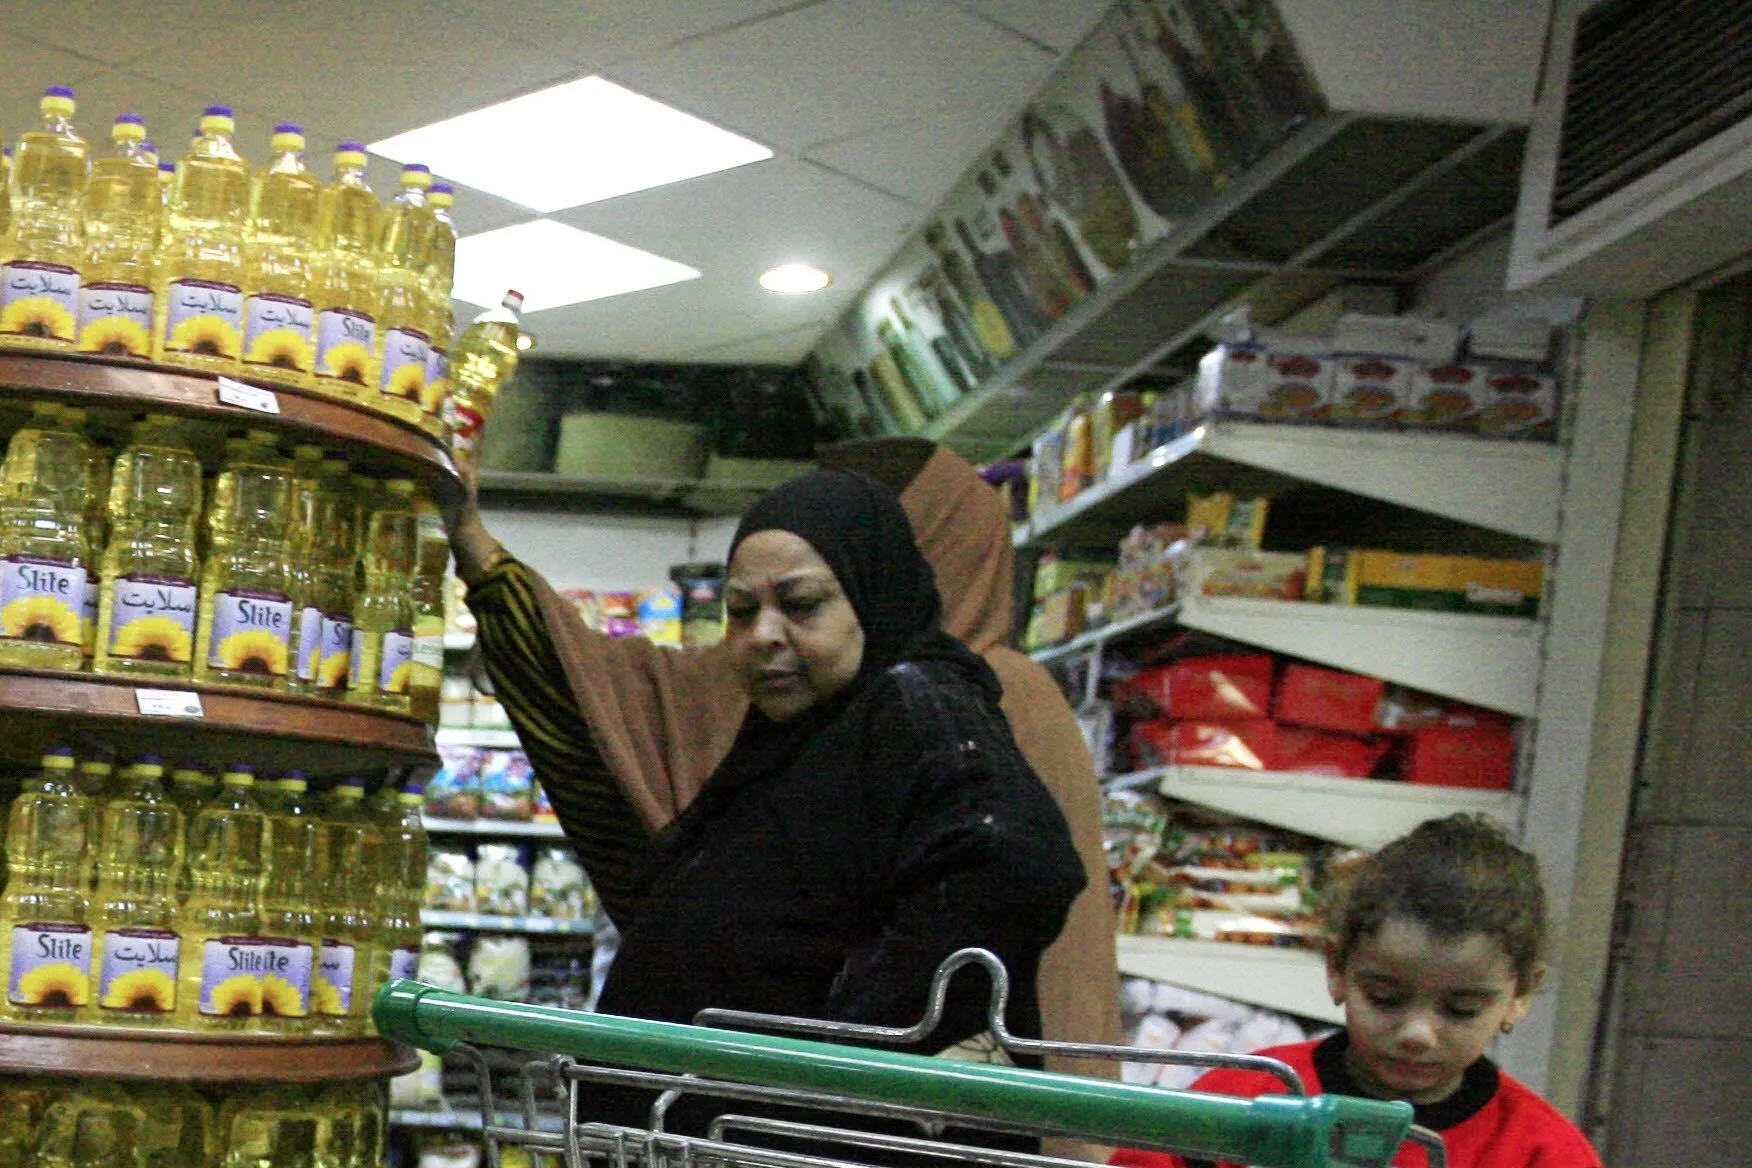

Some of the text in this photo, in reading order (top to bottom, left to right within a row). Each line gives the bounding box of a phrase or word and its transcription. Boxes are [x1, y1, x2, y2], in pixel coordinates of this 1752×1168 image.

[10, 275, 70, 295] سلايت
[17, 565, 70, 595] Slite
[121, 588, 193, 614] سلايت
[236, 599, 283, 628] Slite
[37, 933, 83, 960] Slite
[114, 943, 177, 968] سلايت
